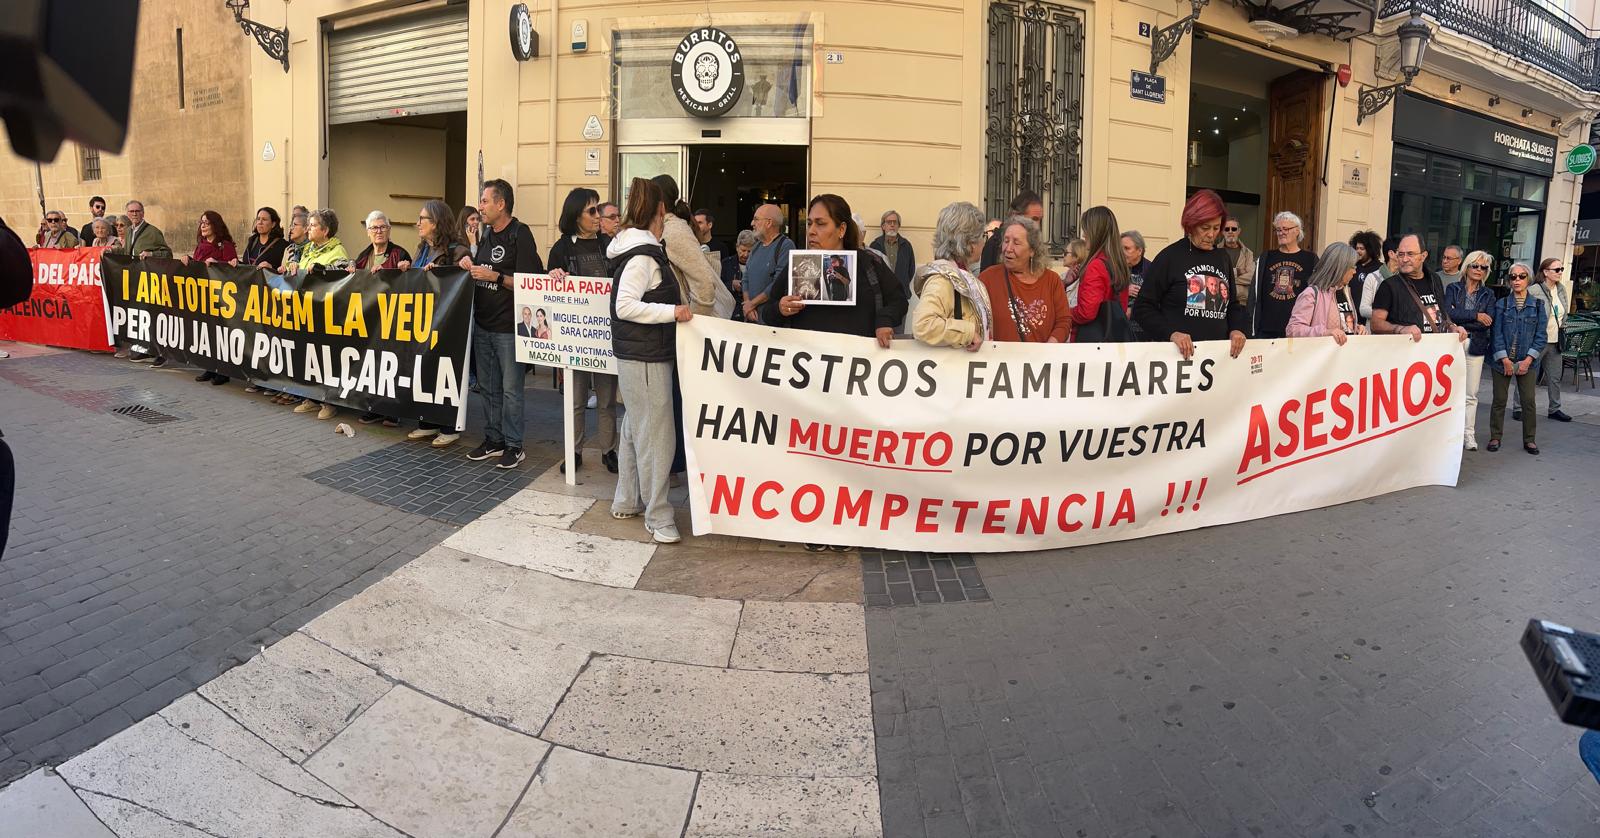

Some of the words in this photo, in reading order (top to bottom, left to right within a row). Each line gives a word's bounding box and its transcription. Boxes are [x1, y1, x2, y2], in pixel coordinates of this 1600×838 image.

[1141, 23, 1148, 36] 2
[674, 29, 740, 64] BURRITOS
[677, 87, 709, 111] MEXICAN
[718, 86, 737, 108] GRILL
[1494, 131, 1530, 152] HORCHATA
[1531, 141, 1554, 157] SUBIES
[38, 263, 65, 285] DEL
[68, 258, 102, 287] PAÍS
[520, 277, 576, 293] JUSTICIA
[578, 280, 613, 295] PARA
[122, 269, 129, 301] I
[135, 271, 172, 308] ARA
[173, 275, 238, 319] TOTES
[242, 284, 315, 333] ALCEM
[324, 291, 369, 338] LA
[377, 292, 439, 350] VEU,
[543, 294, 565, 303] PADRE
[573, 297, 589, 305] HIJA
[1184, 307, 1200, 317] POR
[552, 312, 581, 325] MIGUEL
[582, 315, 611, 327] CARPIO
[560, 325, 581, 338] SARA
[582, 328, 611, 341] CARPIO
[113, 305, 151, 343] PER
[156, 312, 184, 351] QUI
[189, 319, 212, 358] JA
[216, 324, 246, 366] NO
[251, 332, 296, 378] POT
[304, 342, 460, 408] ALÇAR-LA
[528, 350, 561, 363] MAZÓN
[569, 355, 607, 369] PRISIÓN
[529, 340, 556, 351] TODAS
[557, 344, 573, 353] LAS
[575, 345, 613, 358] VICTIMAS
[700, 337, 938, 398] NUESTROS
[965, 358, 1216, 399] FAMILIARES
[1237, 353, 1455, 475] ASESINOS
[695, 403, 779, 446] HAN
[788, 418, 954, 467] MUERTO
[963, 431, 1047, 467] POR
[1059, 418, 1207, 463] VUESTRA
[700, 472, 1136, 535] NCOMPETENCIA
[1161, 477, 1209, 517] !!!
